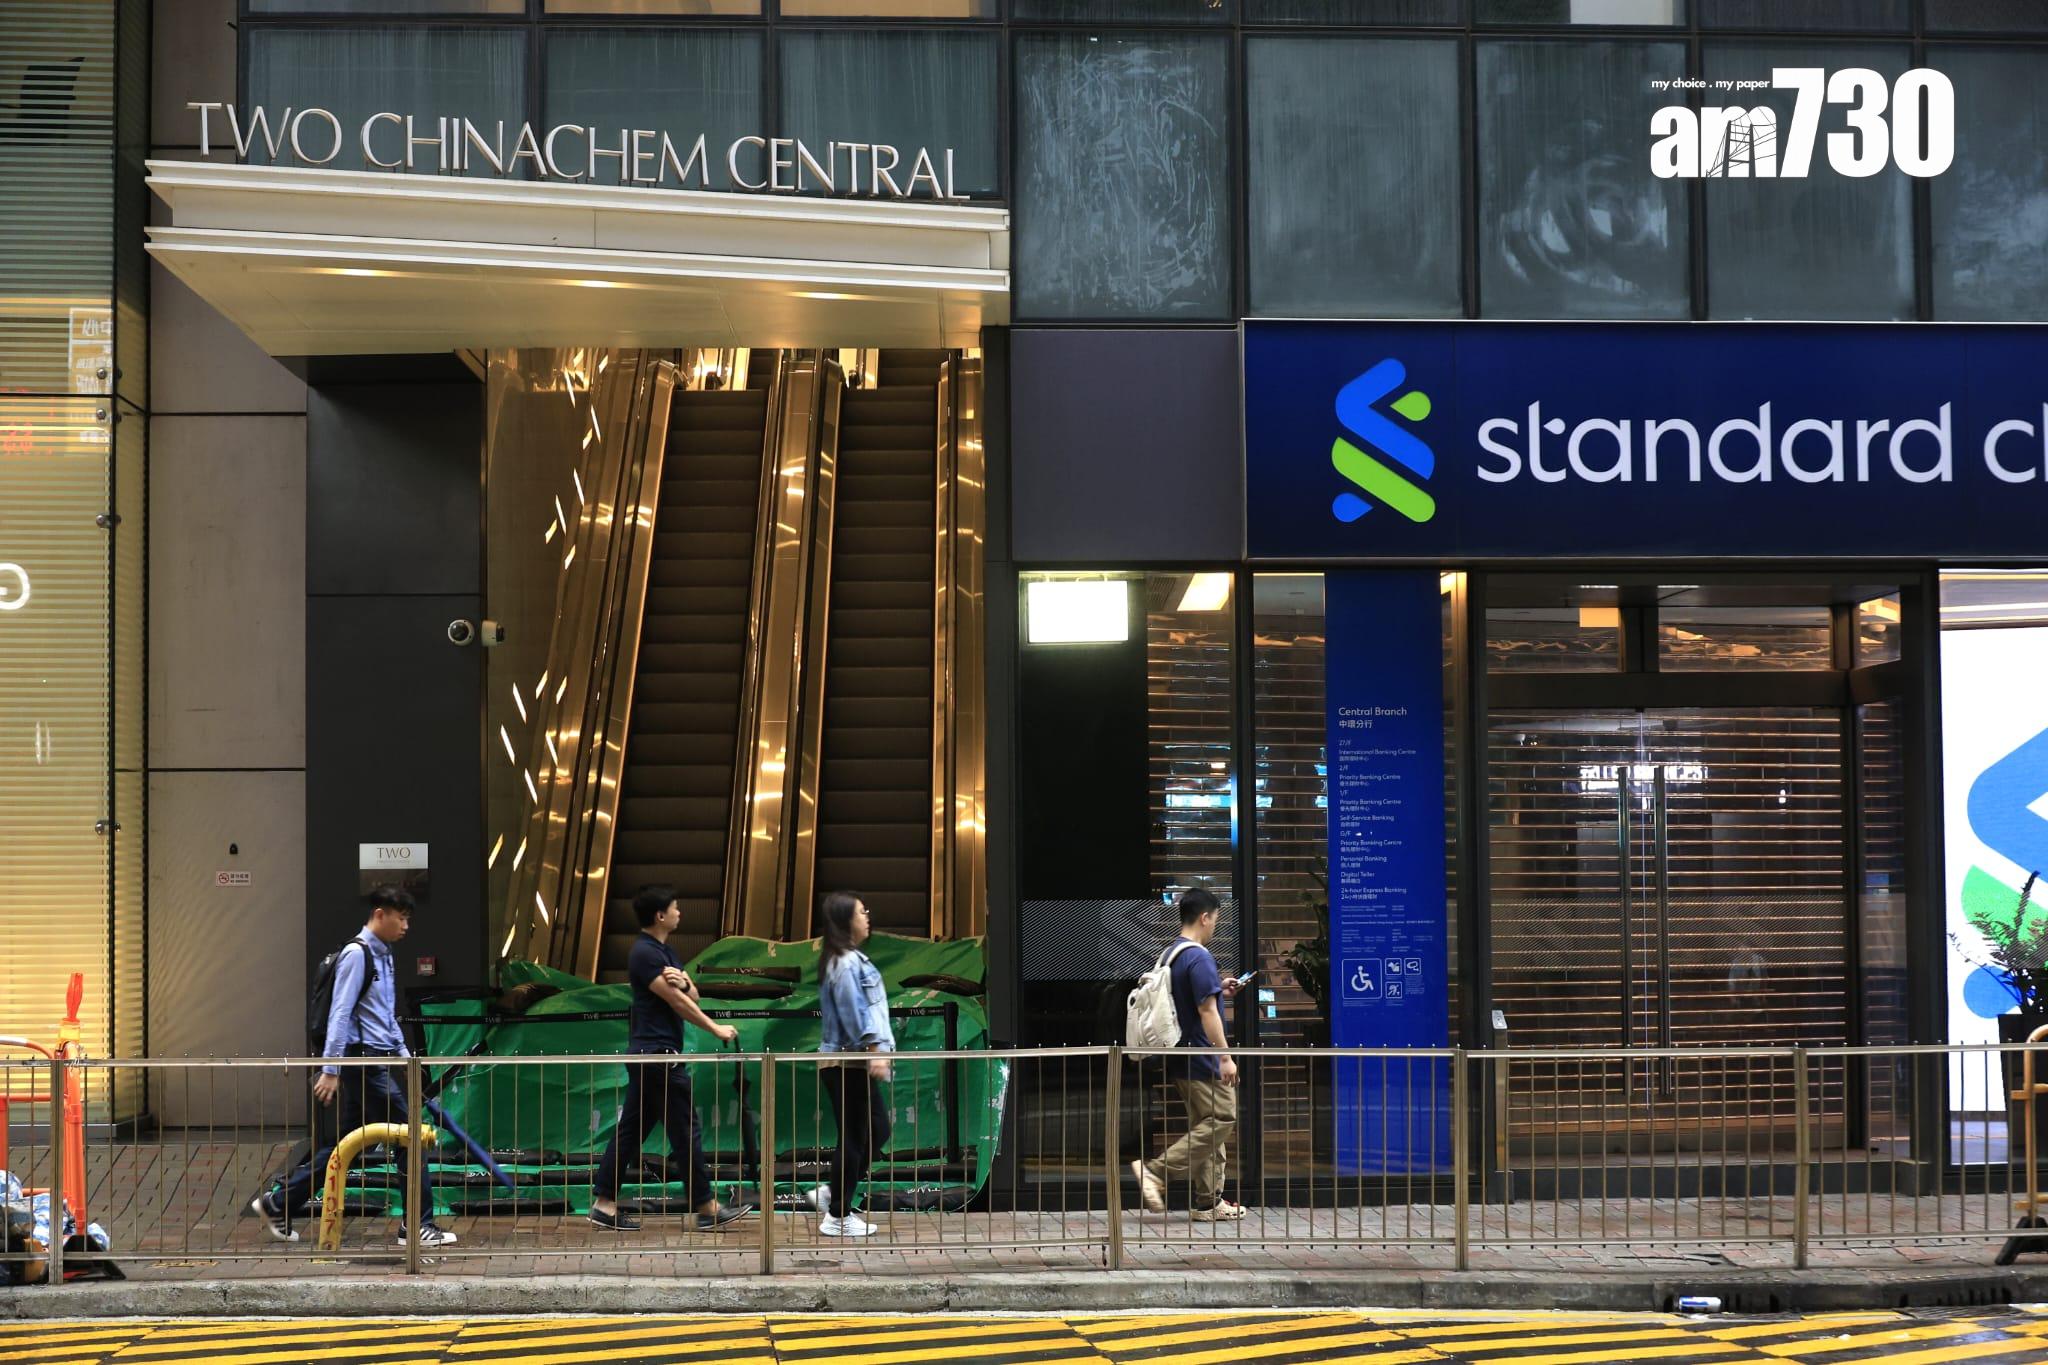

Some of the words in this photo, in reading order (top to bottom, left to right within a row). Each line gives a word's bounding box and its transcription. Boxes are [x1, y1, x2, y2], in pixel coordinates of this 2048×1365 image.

[186, 102, 343, 164] TWO
[360, 112, 709, 187] CHINACHEM
[728, 136, 971, 200] CENTRAL
[1476, 400, 1954, 483] standard
[1984, 402, 2048, 483] c
[1338, 707, 1373, 716] Central
[1375, 706, 1407, 716] Branch
[1339, 719, 1373, 729] 中環分行
[1360, 840, 1383, 848] Banking
[376, 847, 411, 859] TWO
[1364, 855, 1388, 863] Banking
[1363, 887, 1384, 895] Express
[1384, 887, 1407, 895] Banking
